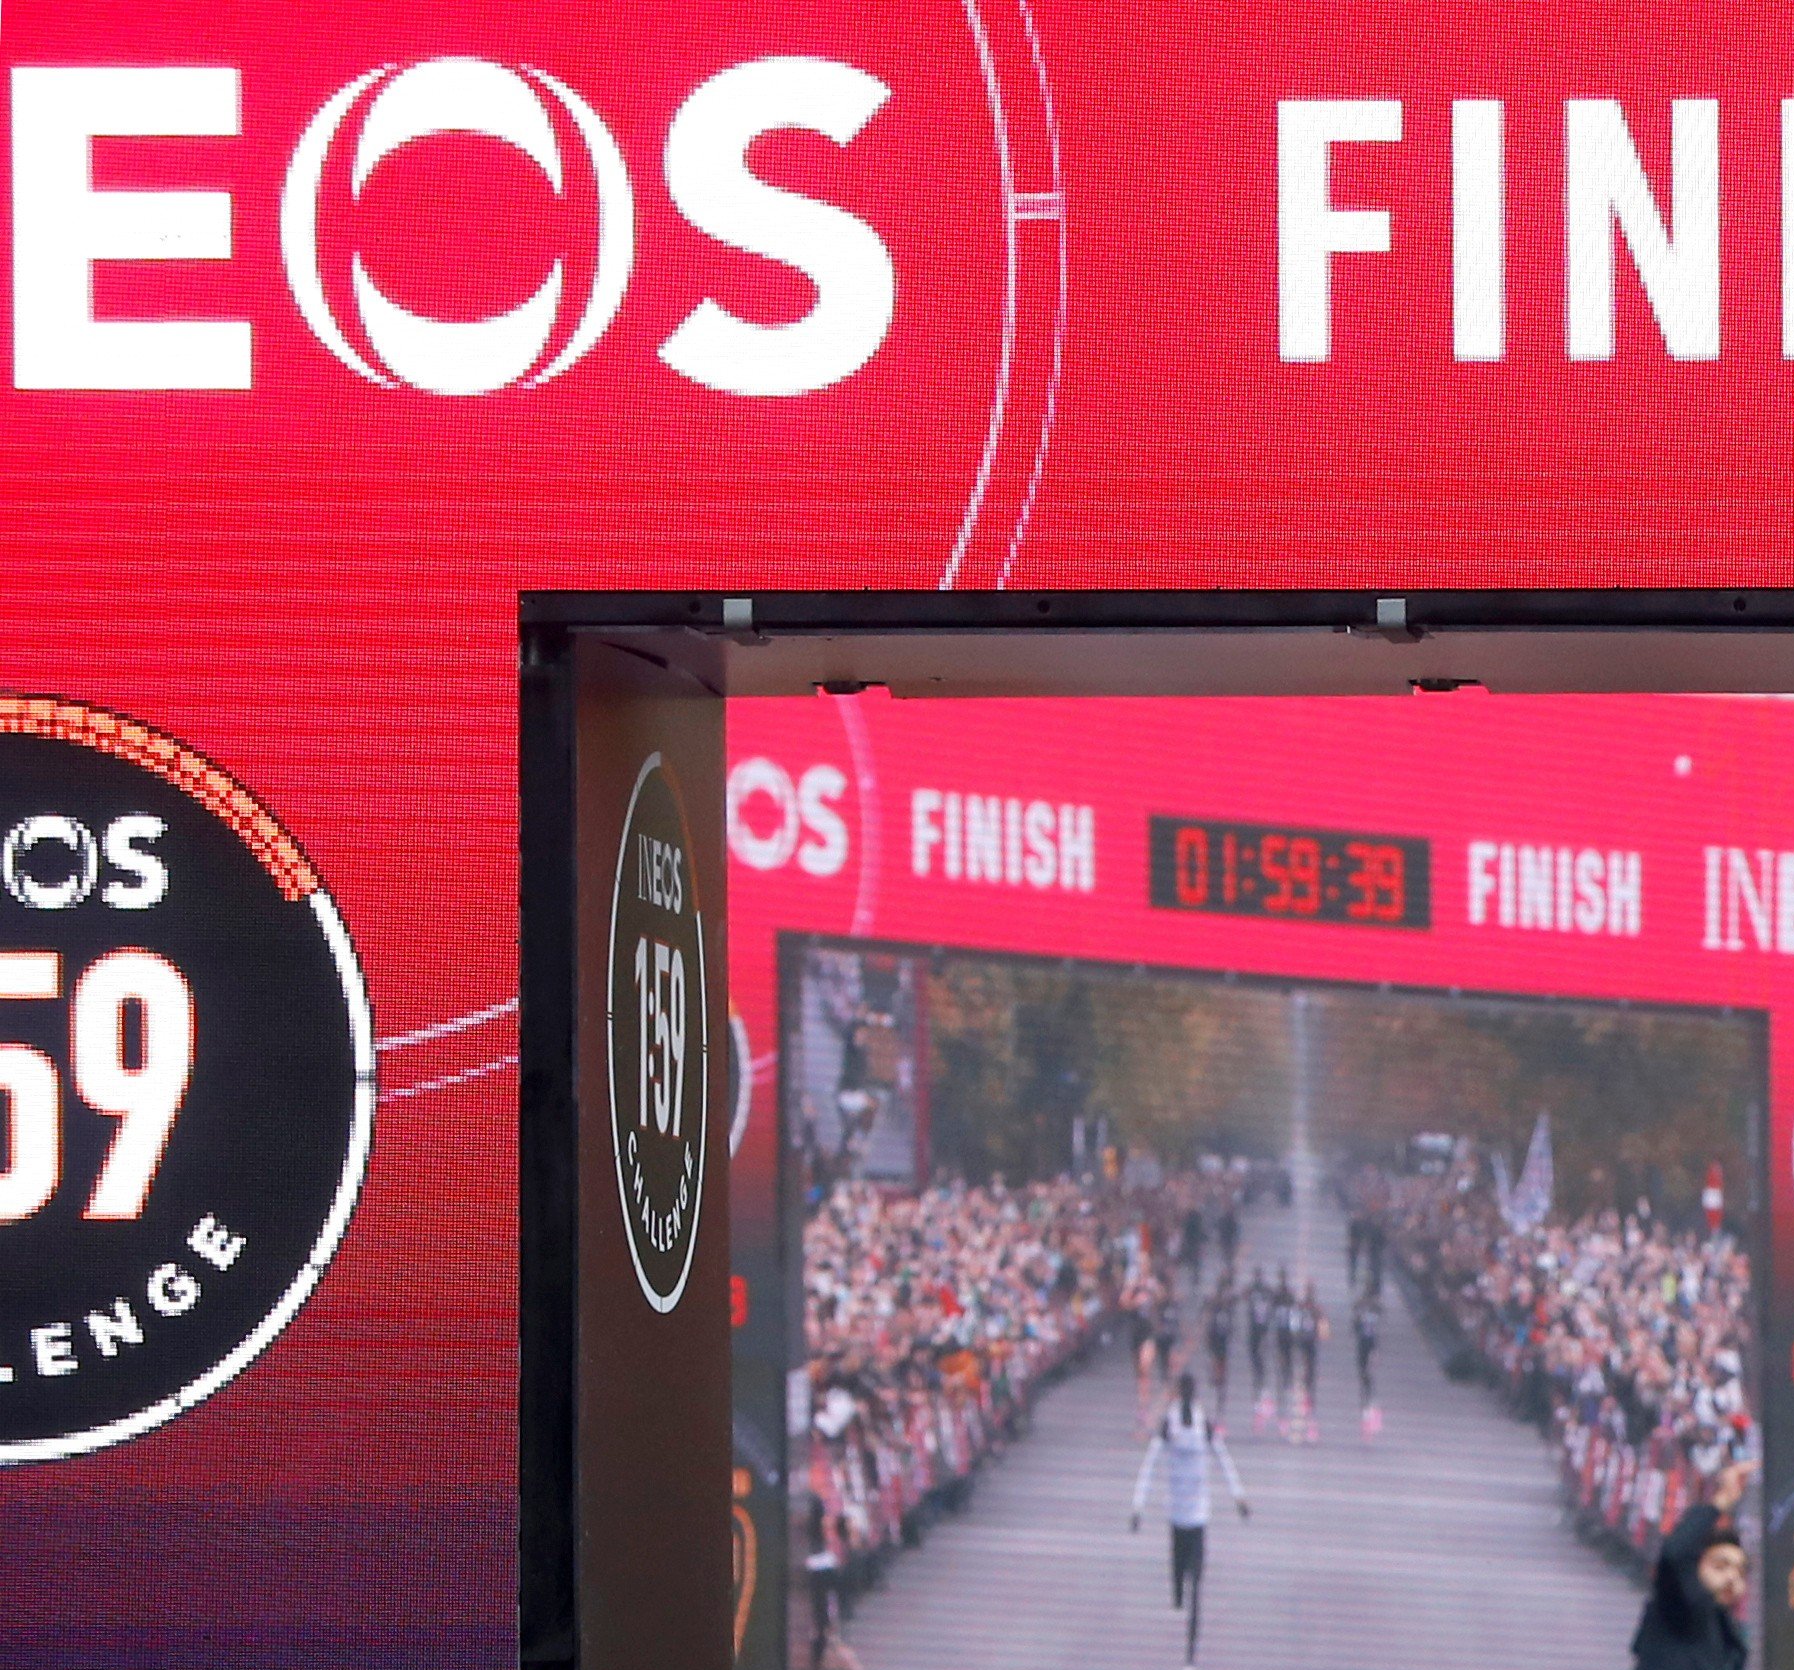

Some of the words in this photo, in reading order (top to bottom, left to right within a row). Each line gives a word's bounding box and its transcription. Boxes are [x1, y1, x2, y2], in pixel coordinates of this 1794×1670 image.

[637, 833, 682, 915] INEOS
[911, 788, 1096, 893] FINISH
[1175, 825, 1405, 922] 01:59:39
[1466, 841, 1642, 938] FINISH
[635, 935, 686, 1140] 1:59
[627, 1130, 694, 1252] CHALLENGE
